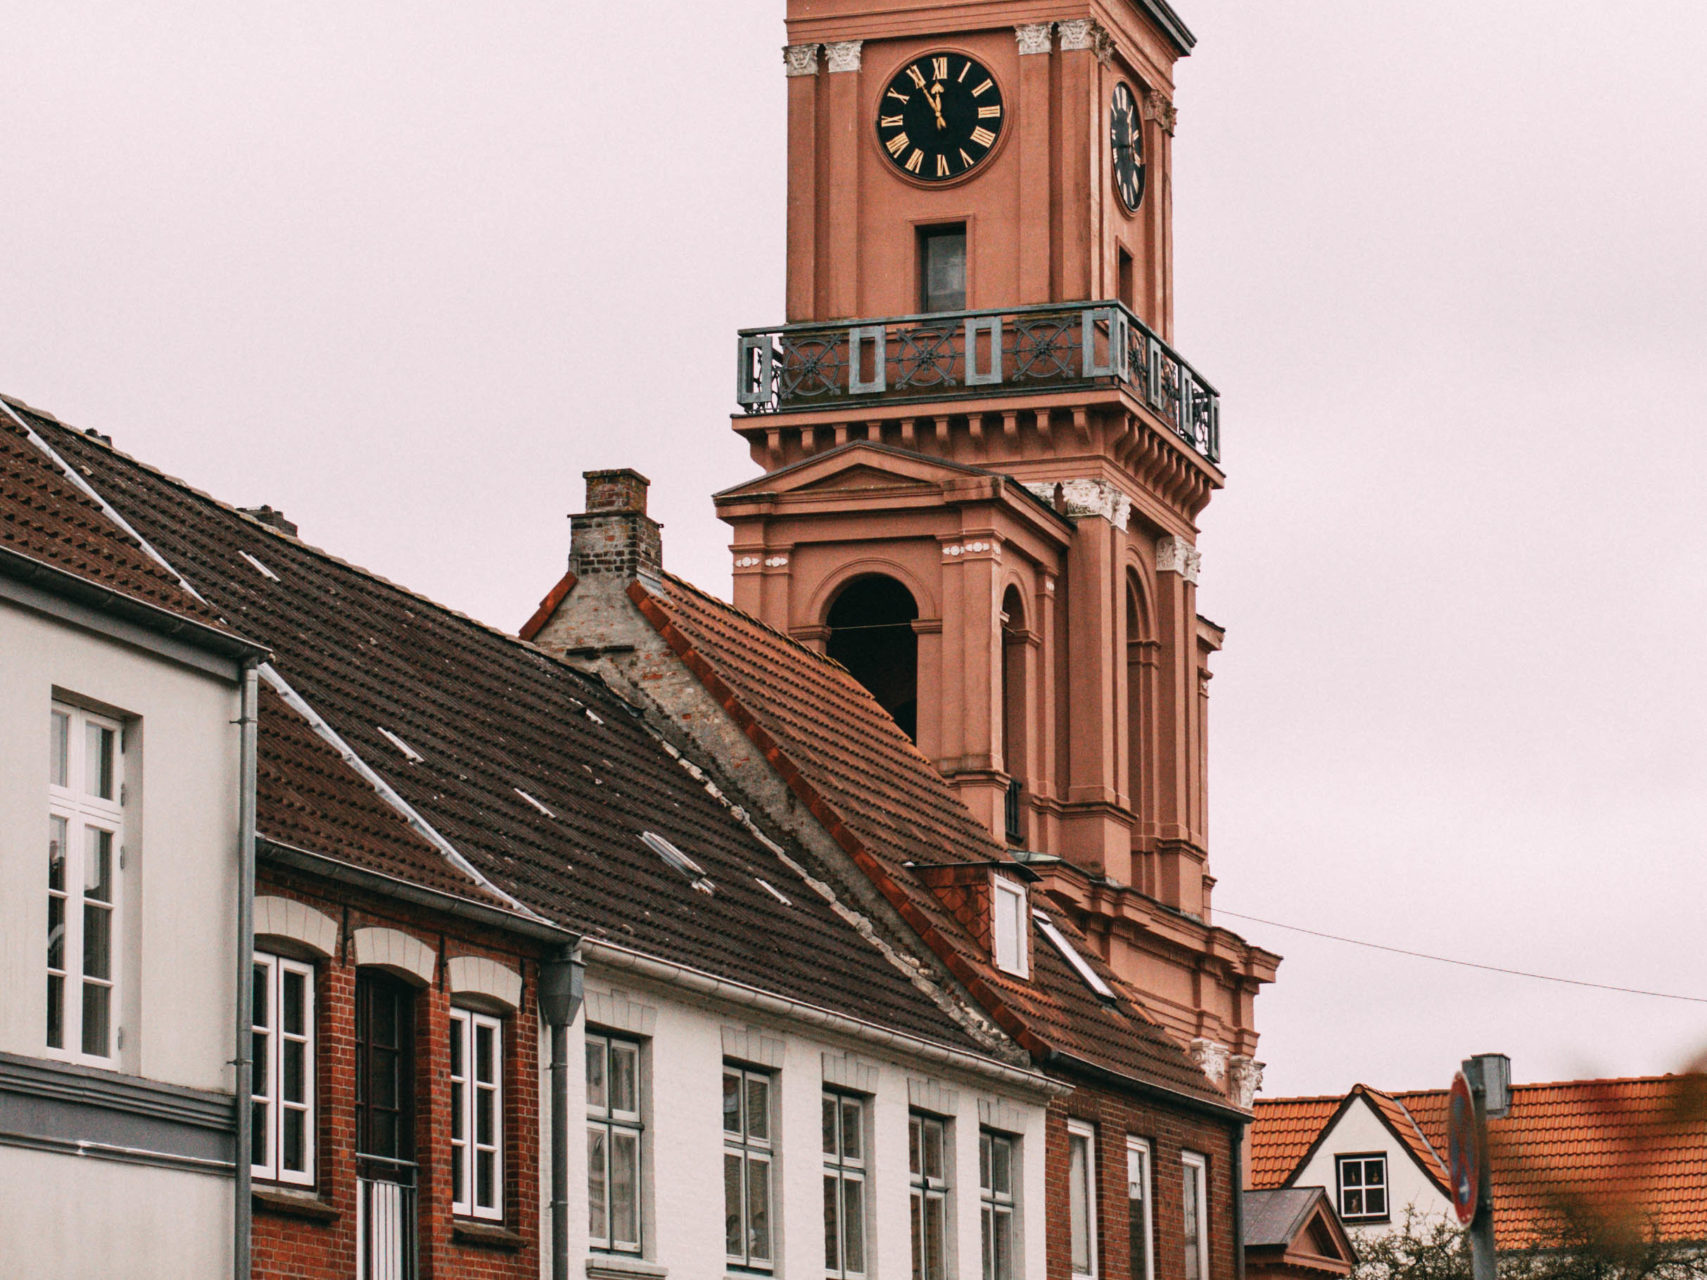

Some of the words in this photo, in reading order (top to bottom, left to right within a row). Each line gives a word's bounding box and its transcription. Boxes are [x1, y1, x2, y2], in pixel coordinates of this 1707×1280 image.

[906, 65, 926, 88] XI
[932, 57, 947, 80] XII
[957, 62, 971, 82] I
[887, 88, 910, 104] X
[971, 79, 992, 98] II
[881, 114, 904, 127] IX
[978, 105, 1000, 119] III
[886, 132, 910, 157] VIII
[905, 148, 924, 173] VII
[937, 154, 950, 176] VI
[959, 148, 974, 168] V
